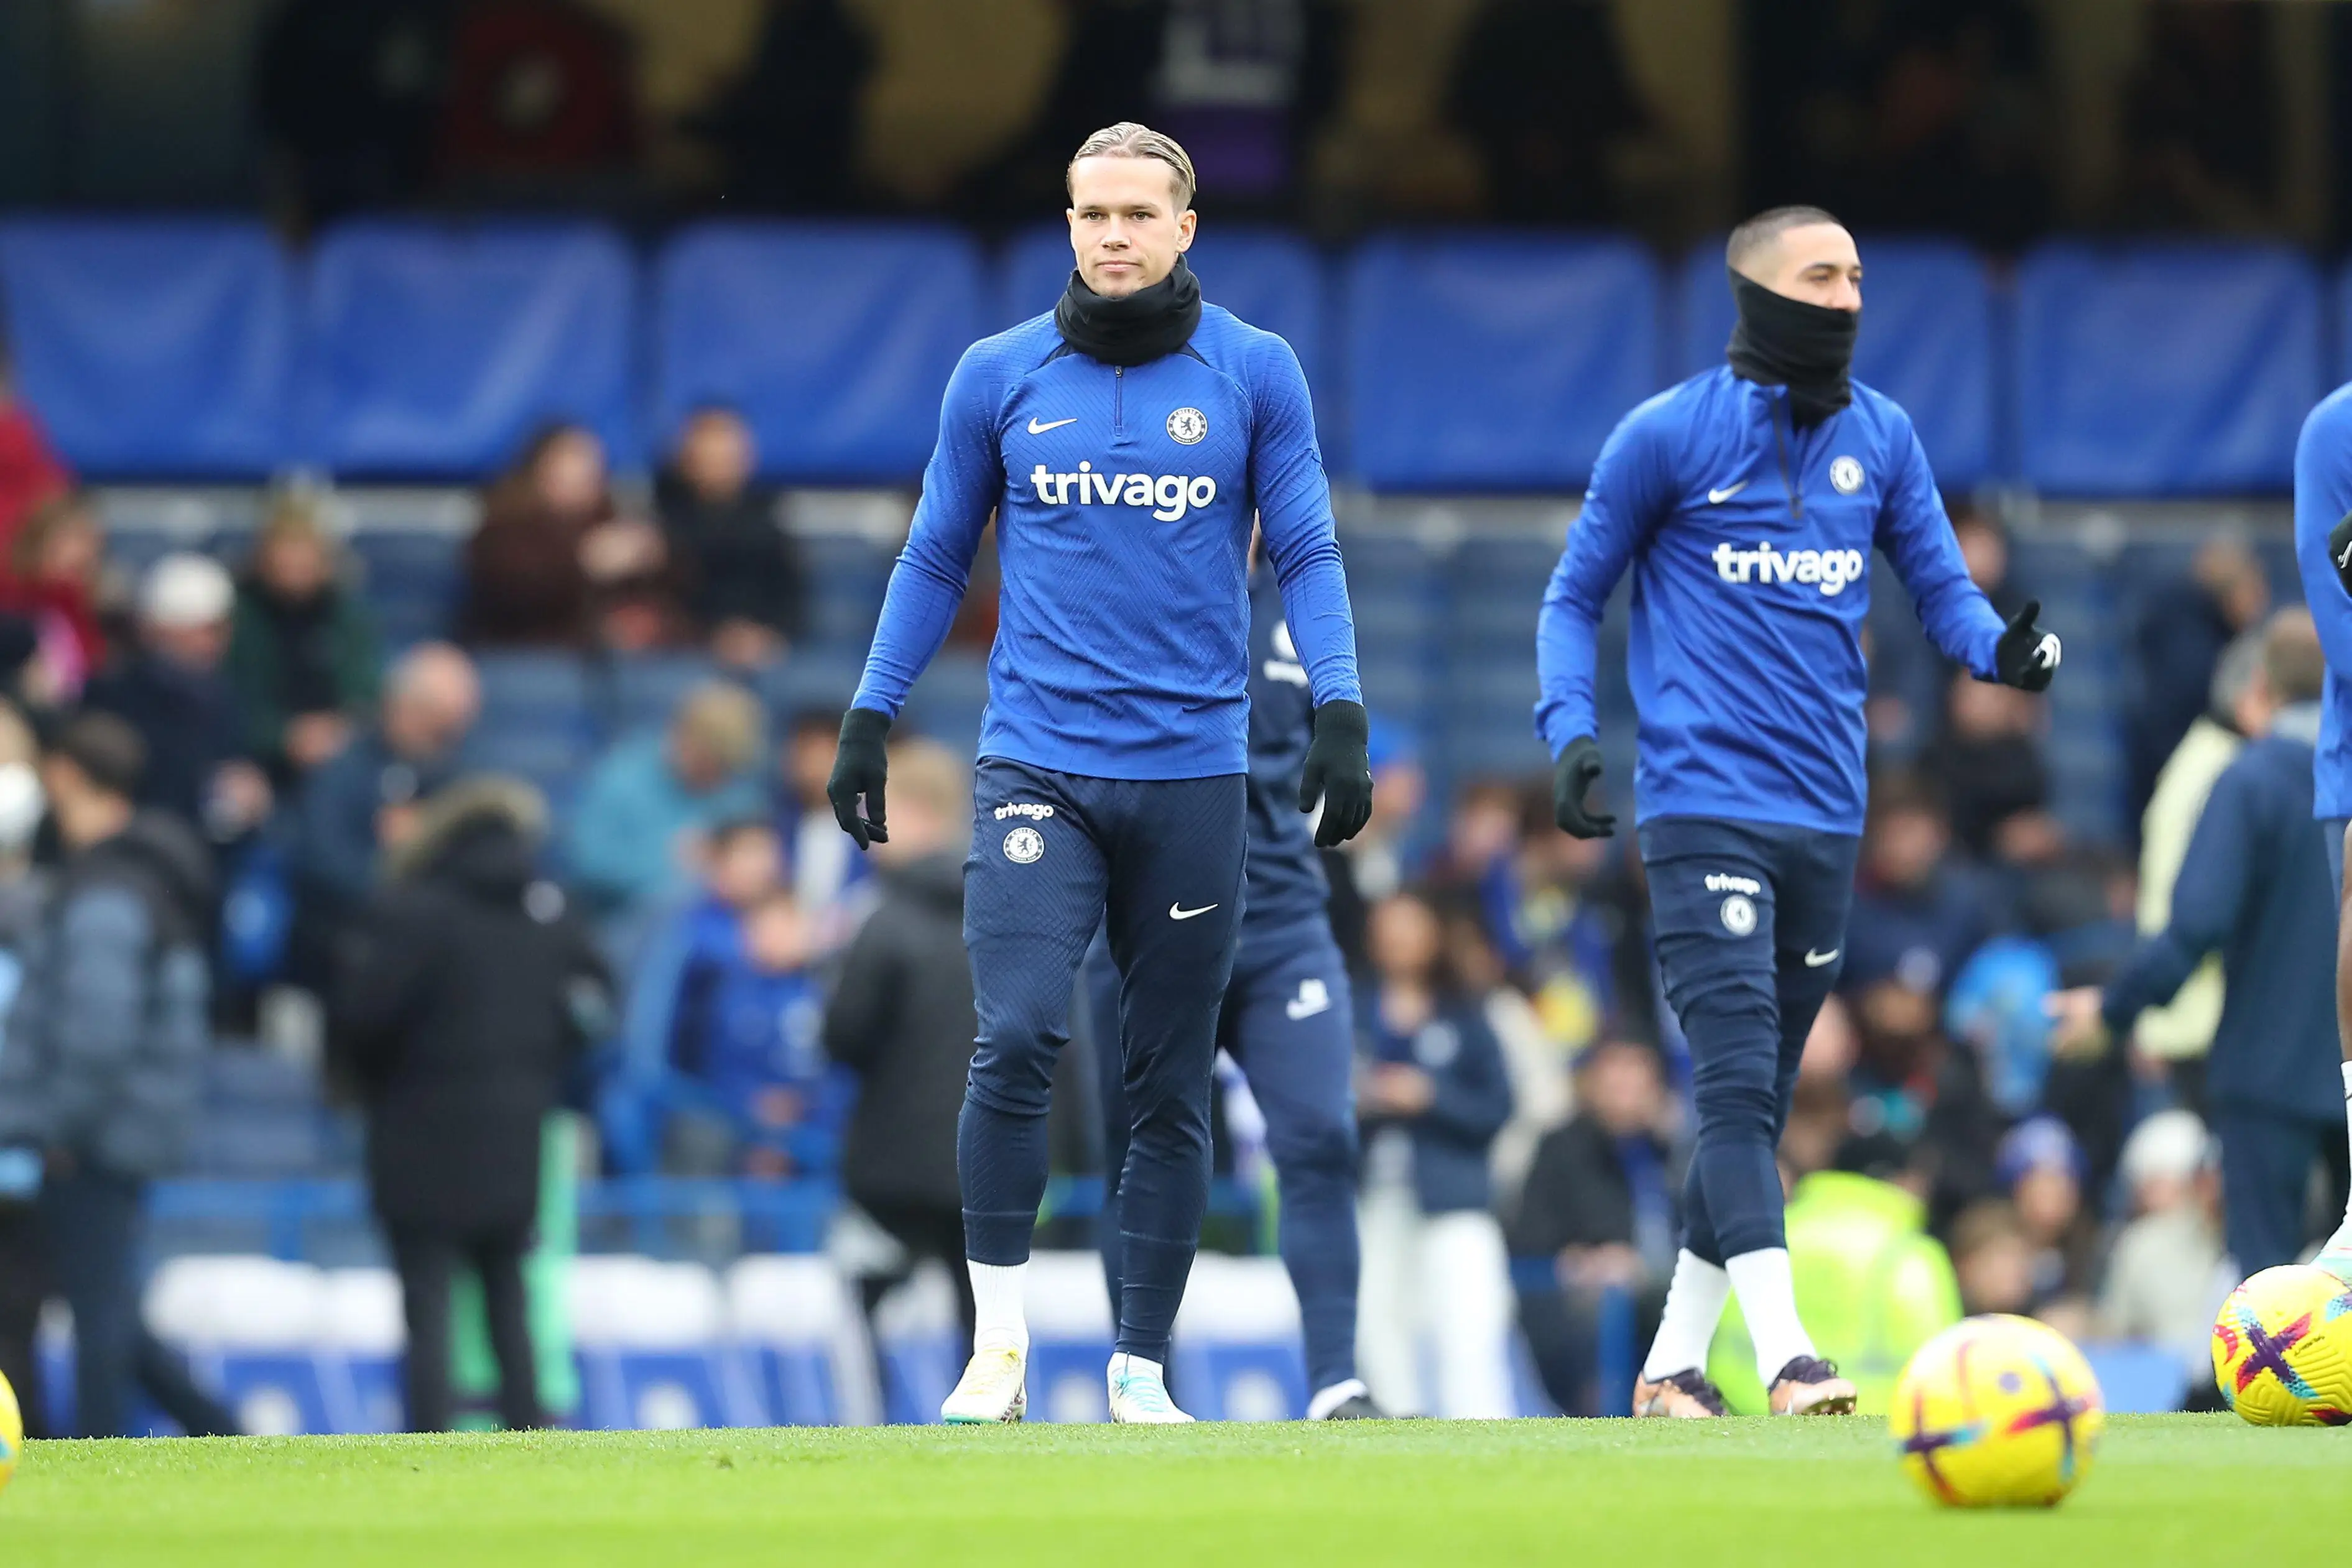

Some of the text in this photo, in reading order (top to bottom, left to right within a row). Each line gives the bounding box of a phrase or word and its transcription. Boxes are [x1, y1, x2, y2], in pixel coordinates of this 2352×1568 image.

[1030, 461, 1216, 522] trivago
[1711, 541, 1863, 597] trivago
[994, 802, 1054, 820] trivago
